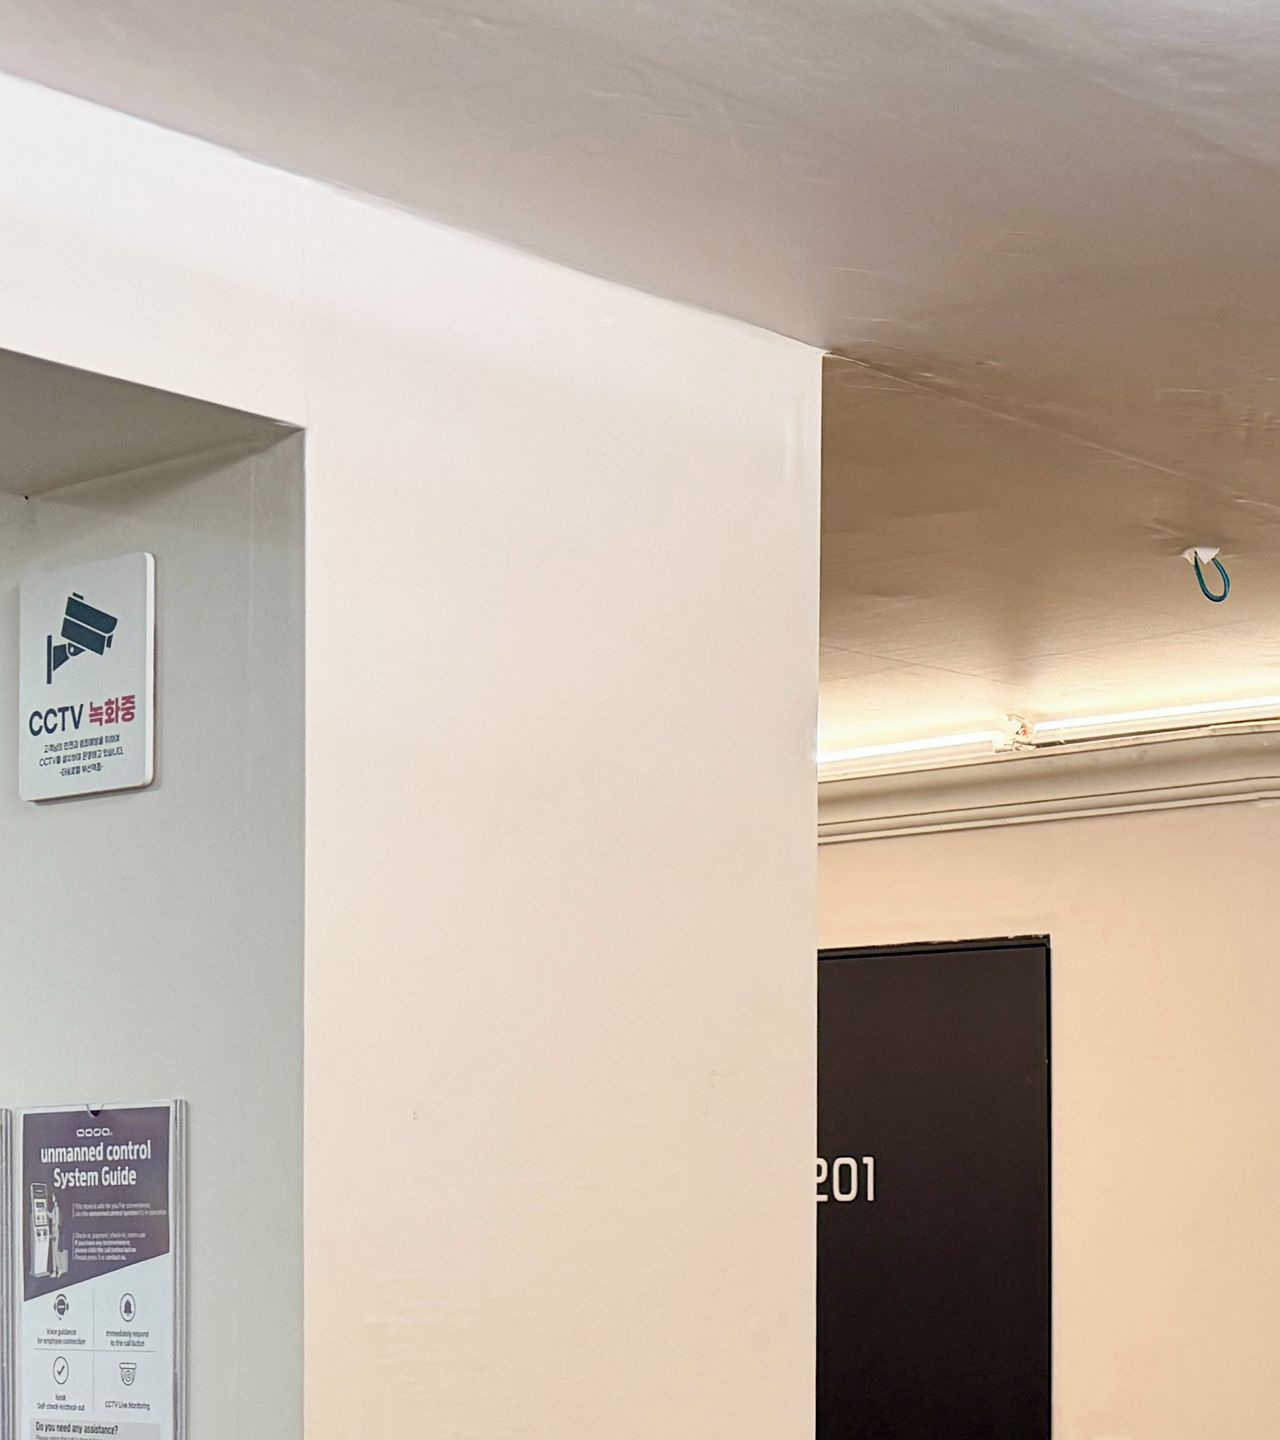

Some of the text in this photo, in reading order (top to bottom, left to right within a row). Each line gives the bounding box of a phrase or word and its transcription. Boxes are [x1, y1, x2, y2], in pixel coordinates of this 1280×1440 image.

[29, 695, 136, 737] CCTV 녹화중
[40, 1139, 152, 1163] unmanned control
[53, 1166, 137, 1189] System Guide
[35, 1421, 118, 1435] Do you need any assistance?
